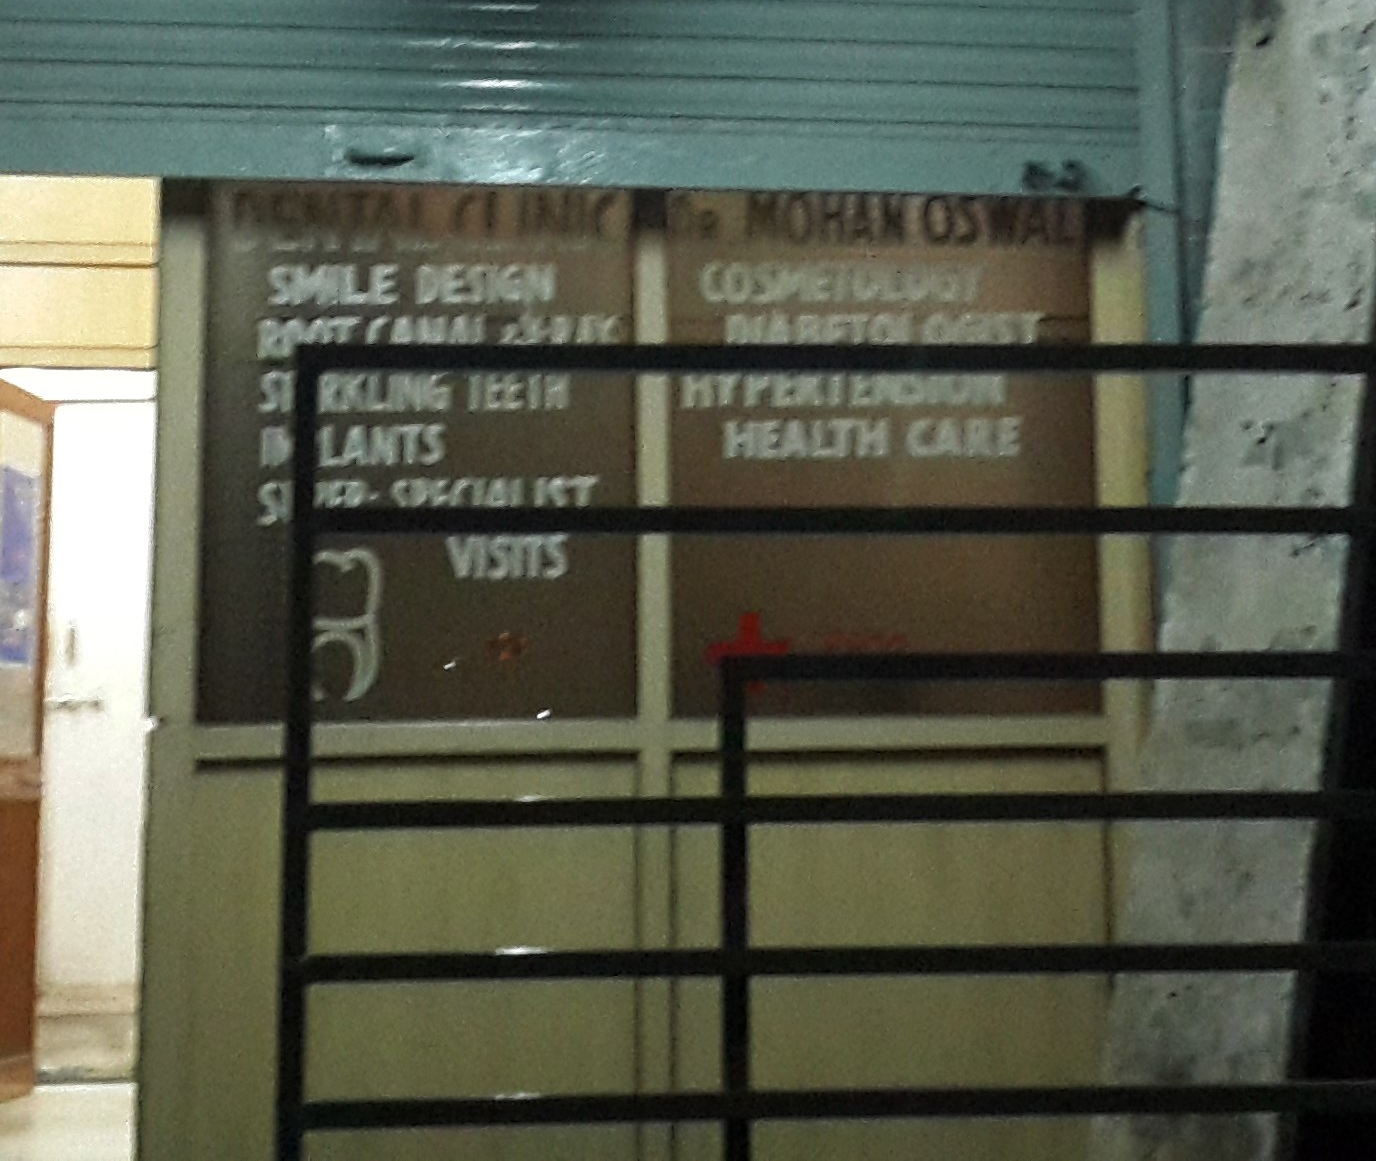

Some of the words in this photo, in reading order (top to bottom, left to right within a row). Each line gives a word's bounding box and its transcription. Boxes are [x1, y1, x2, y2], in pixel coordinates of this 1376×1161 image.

[267, 263, 400, 306] SMILE
[414, 262, 560, 305] DESIGN
[465, 372, 572, 411] TEETH
[723, 416, 892, 460] HEALTH
[905, 416, 1022, 460] CARE
